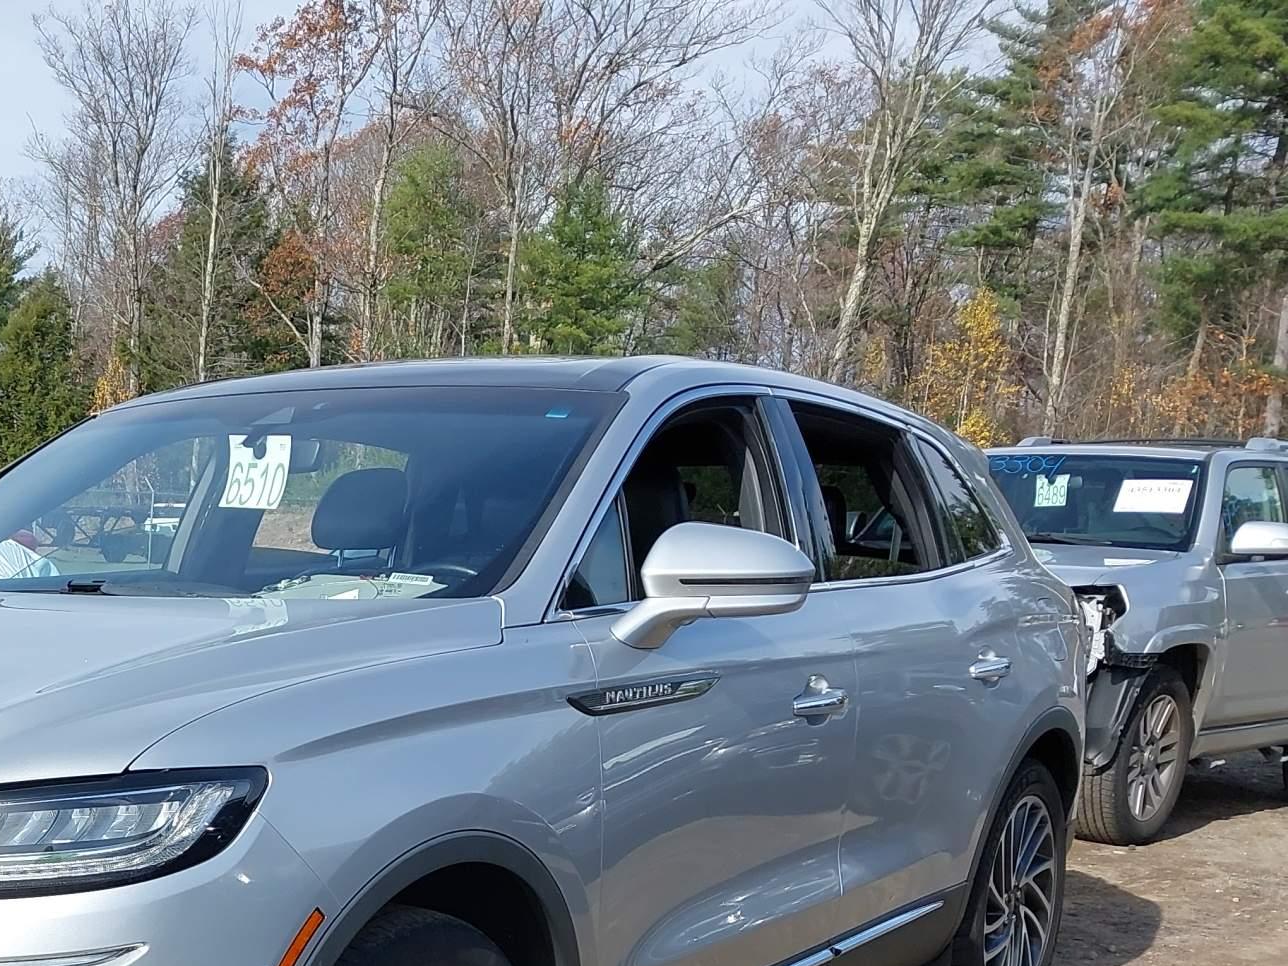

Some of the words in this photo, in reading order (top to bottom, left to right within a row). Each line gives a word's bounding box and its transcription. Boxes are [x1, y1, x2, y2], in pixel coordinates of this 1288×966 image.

[225, 461, 286, 507] 6510
[1037, 484, 1066, 506] 6489
[605, 682, 673, 704] NAUTILUS
